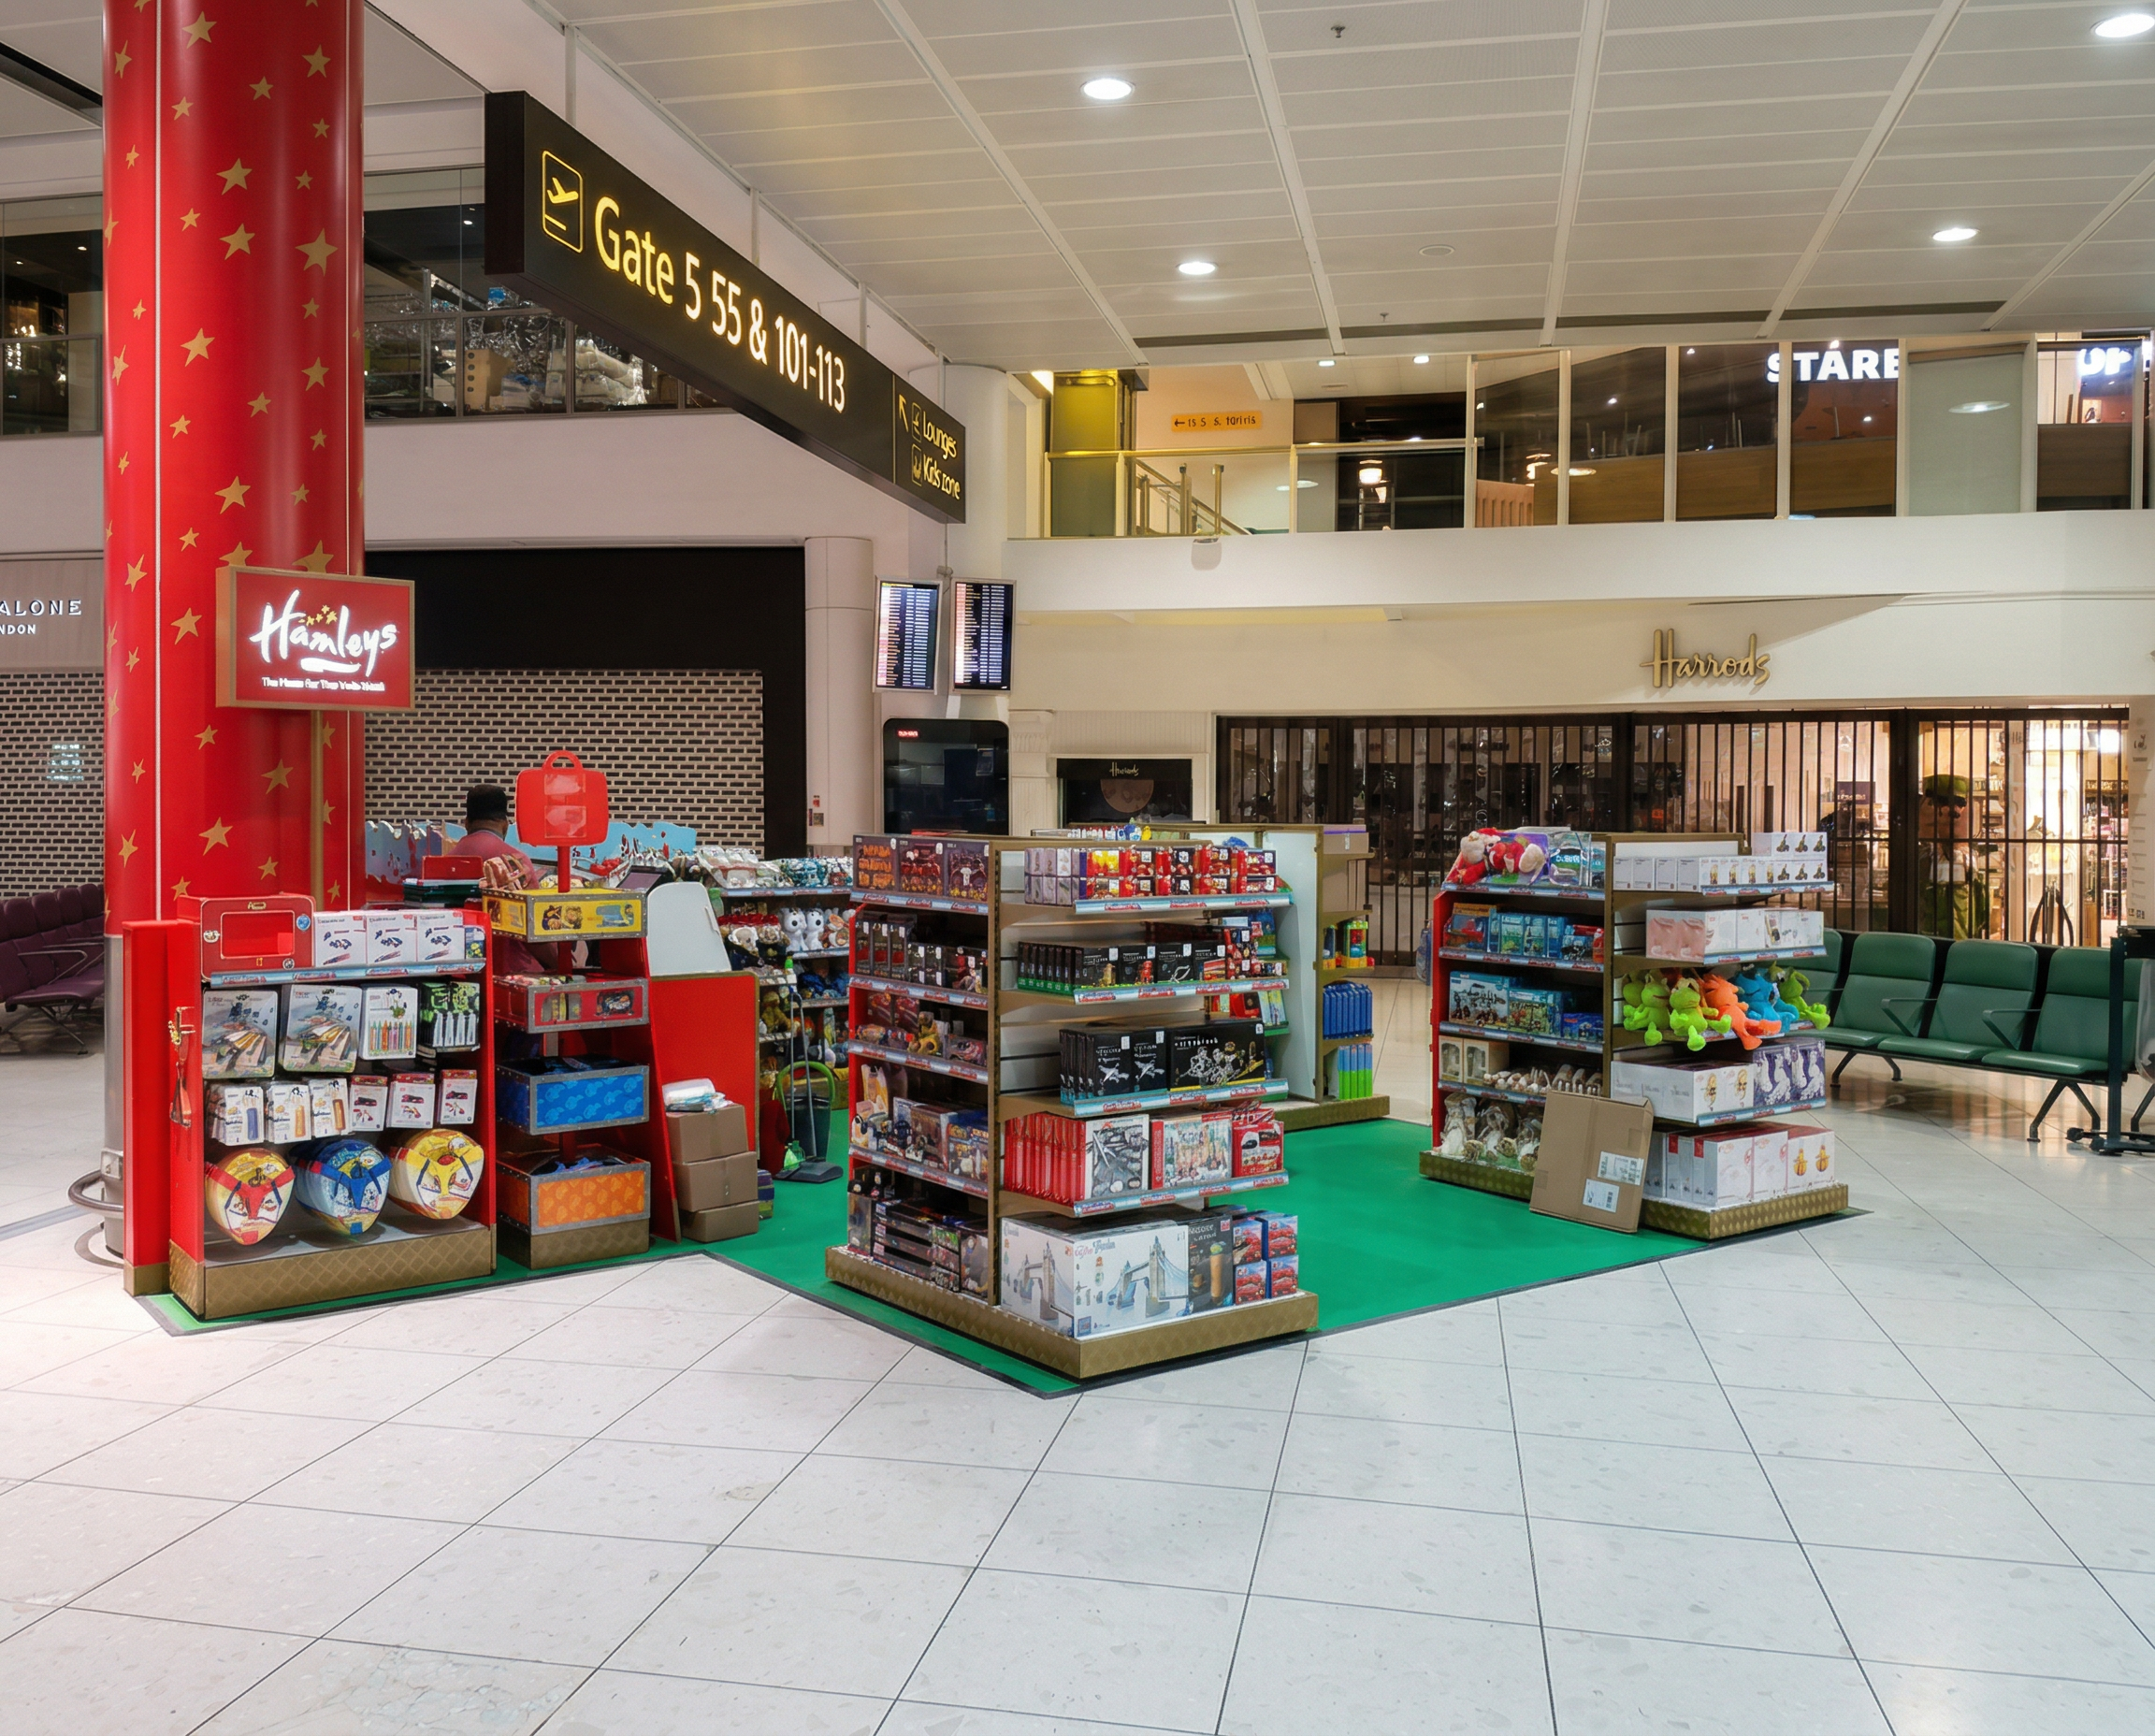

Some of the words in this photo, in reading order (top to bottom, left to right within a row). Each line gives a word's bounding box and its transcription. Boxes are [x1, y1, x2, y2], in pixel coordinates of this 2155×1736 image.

[594, 195, 674, 305] Gate
[712, 269, 742, 345] 55
[749, 298, 768, 366] &
[774, 314, 846, 413] 101-113
[0, 599, 82, 616] ALONE
[249, 588, 398, 678] Hamleys
[1639, 628, 1772, 688] Harrods
